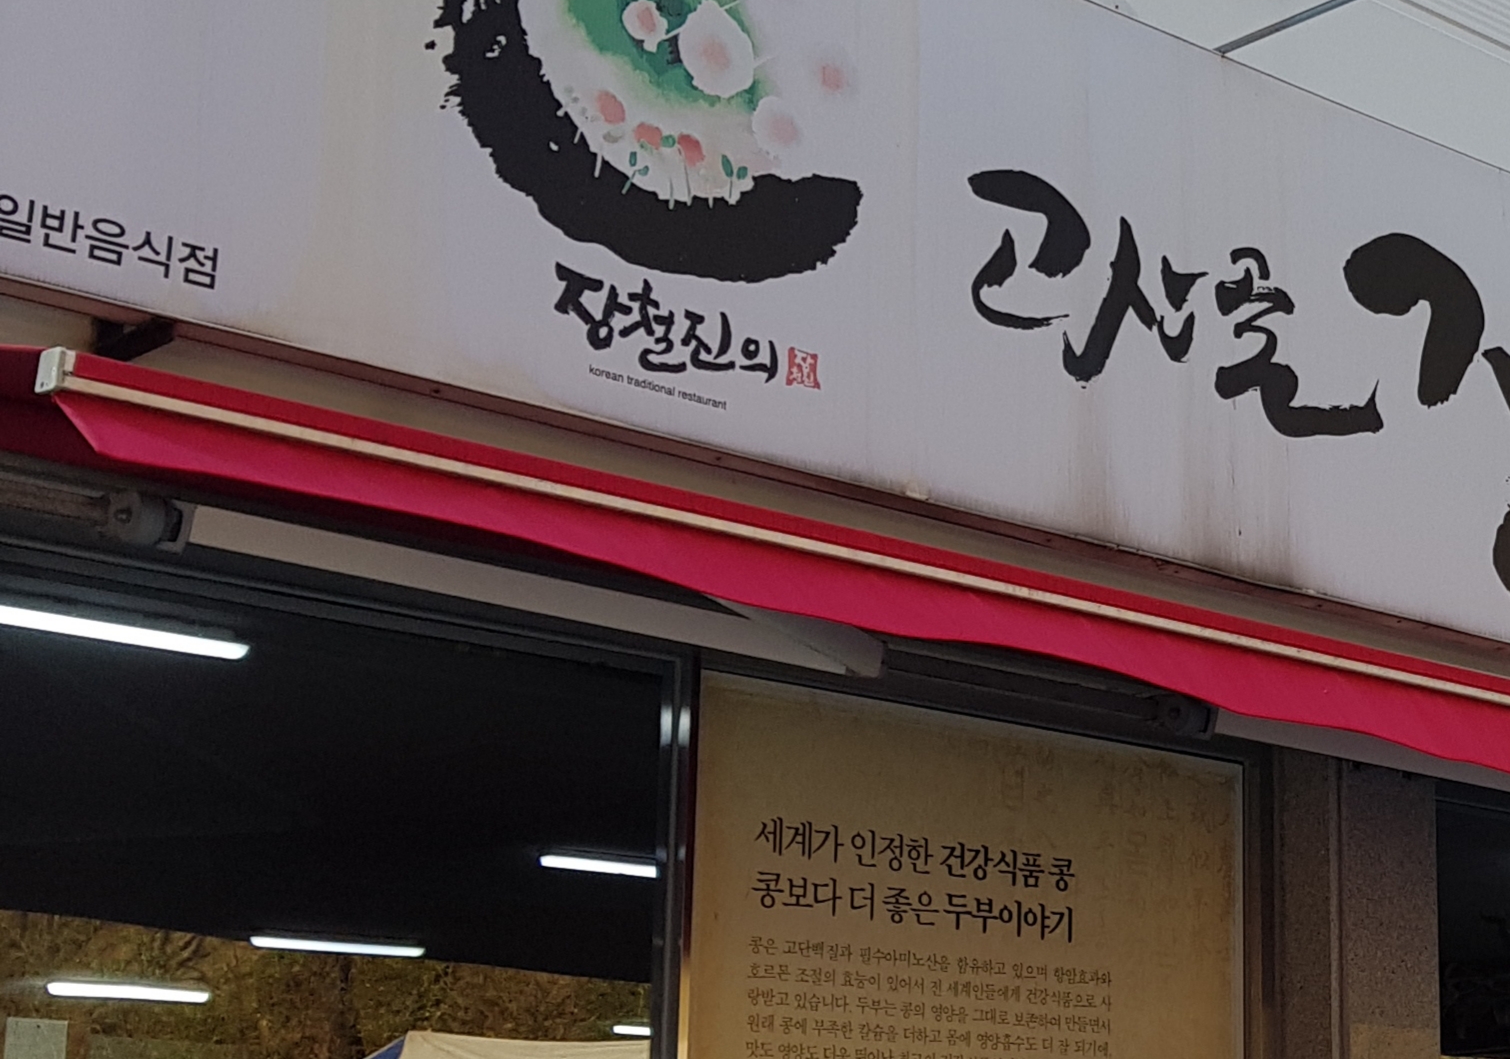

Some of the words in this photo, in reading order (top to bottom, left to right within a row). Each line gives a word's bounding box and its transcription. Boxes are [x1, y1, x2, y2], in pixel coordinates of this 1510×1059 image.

[0, 194, 219, 290] 일반음식점
[553, 261, 779, 384] 장철진의
[588, 364, 625, 384] korean
[626, 375, 676, 397] traditional
[677, 389, 728, 411] restaurant
[753, 816, 844, 863] 세계가
[849, 829, 933, 875] 인정한
[939, 842, 1045, 887] 건강식품
[1047, 856, 1076, 892] 콩
[751, 870, 842, 918] 콩보다
[848, 881, 876, 921] 더
[881, 886, 941, 926] 좋은
[942, 891, 1074, 943] 두부이야기
[747, 963, 791, 982] 호르몬
[794, 967, 836, 987] 조절의
[840, 971, 881, 991] 효능이
[886, 974, 926, 995] 있어서
[946, 980, 1021, 1003] 세계인들에게
[1024, 986, 1098, 1010] 건강식품으로
[749, 936, 779, 956] 콩은
[859, 946, 951, 973] 필수아미노산을
[956, 956, 1007, 976] 함유하고
[1011, 961, 1048, 981] 있으며
[1052, 966, 1112, 987] 항암효과와
[747, 986, 790, 1007] 랑받고
[794, 992, 852, 1013] 있습니다.
[856, 996, 898, 1018] 두부는
[900, 1001, 926, 1021] 콩의
[930, 1003, 969, 1024] 영양을
[971, 1007, 1010, 1026] 그대로
[1012, 1011, 1062, 1031] 보존하여
[1064, 1014, 1112, 1036] 만들면서
[747, 1013, 775, 1034] 원래
[811, 1018, 853, 1041] 부족한
[857, 1022, 900, 1044] 칼슘을
[903, 1026, 943, 1046] 더하고
[946, 1028, 972, 1048] 몸에
[976, 1032, 1039, 1053] 영양흡수도
[1057, 1038, 1071, 1057] 잘
